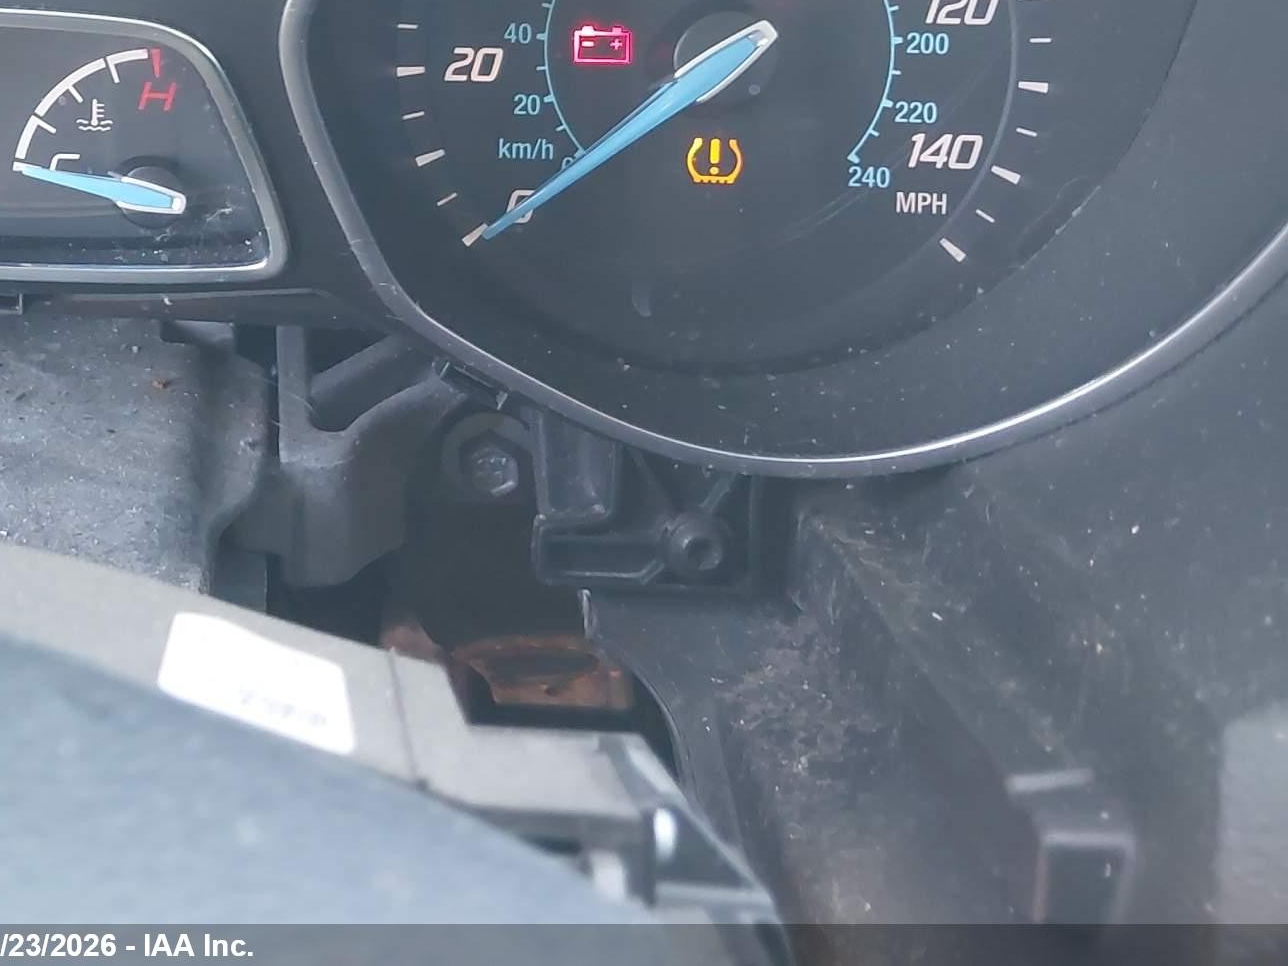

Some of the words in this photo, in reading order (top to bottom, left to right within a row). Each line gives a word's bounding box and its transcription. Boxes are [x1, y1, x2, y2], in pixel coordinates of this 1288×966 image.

[504, 22, 532, 44] 40
[906, 31, 949, 55] 200
[444, 47, 503, 82] 20
[138, 82, 177, 111] H
[513, 94, 541, 116] 20
[894, 101, 938, 124] 220
[498, 137, 554, 160] km/h
[906, 134, 983, 170] 140
[847, 166, 890, 190] 240
[506, 189, 536, 223] 0
[894, 191, 948, 215] MPH
